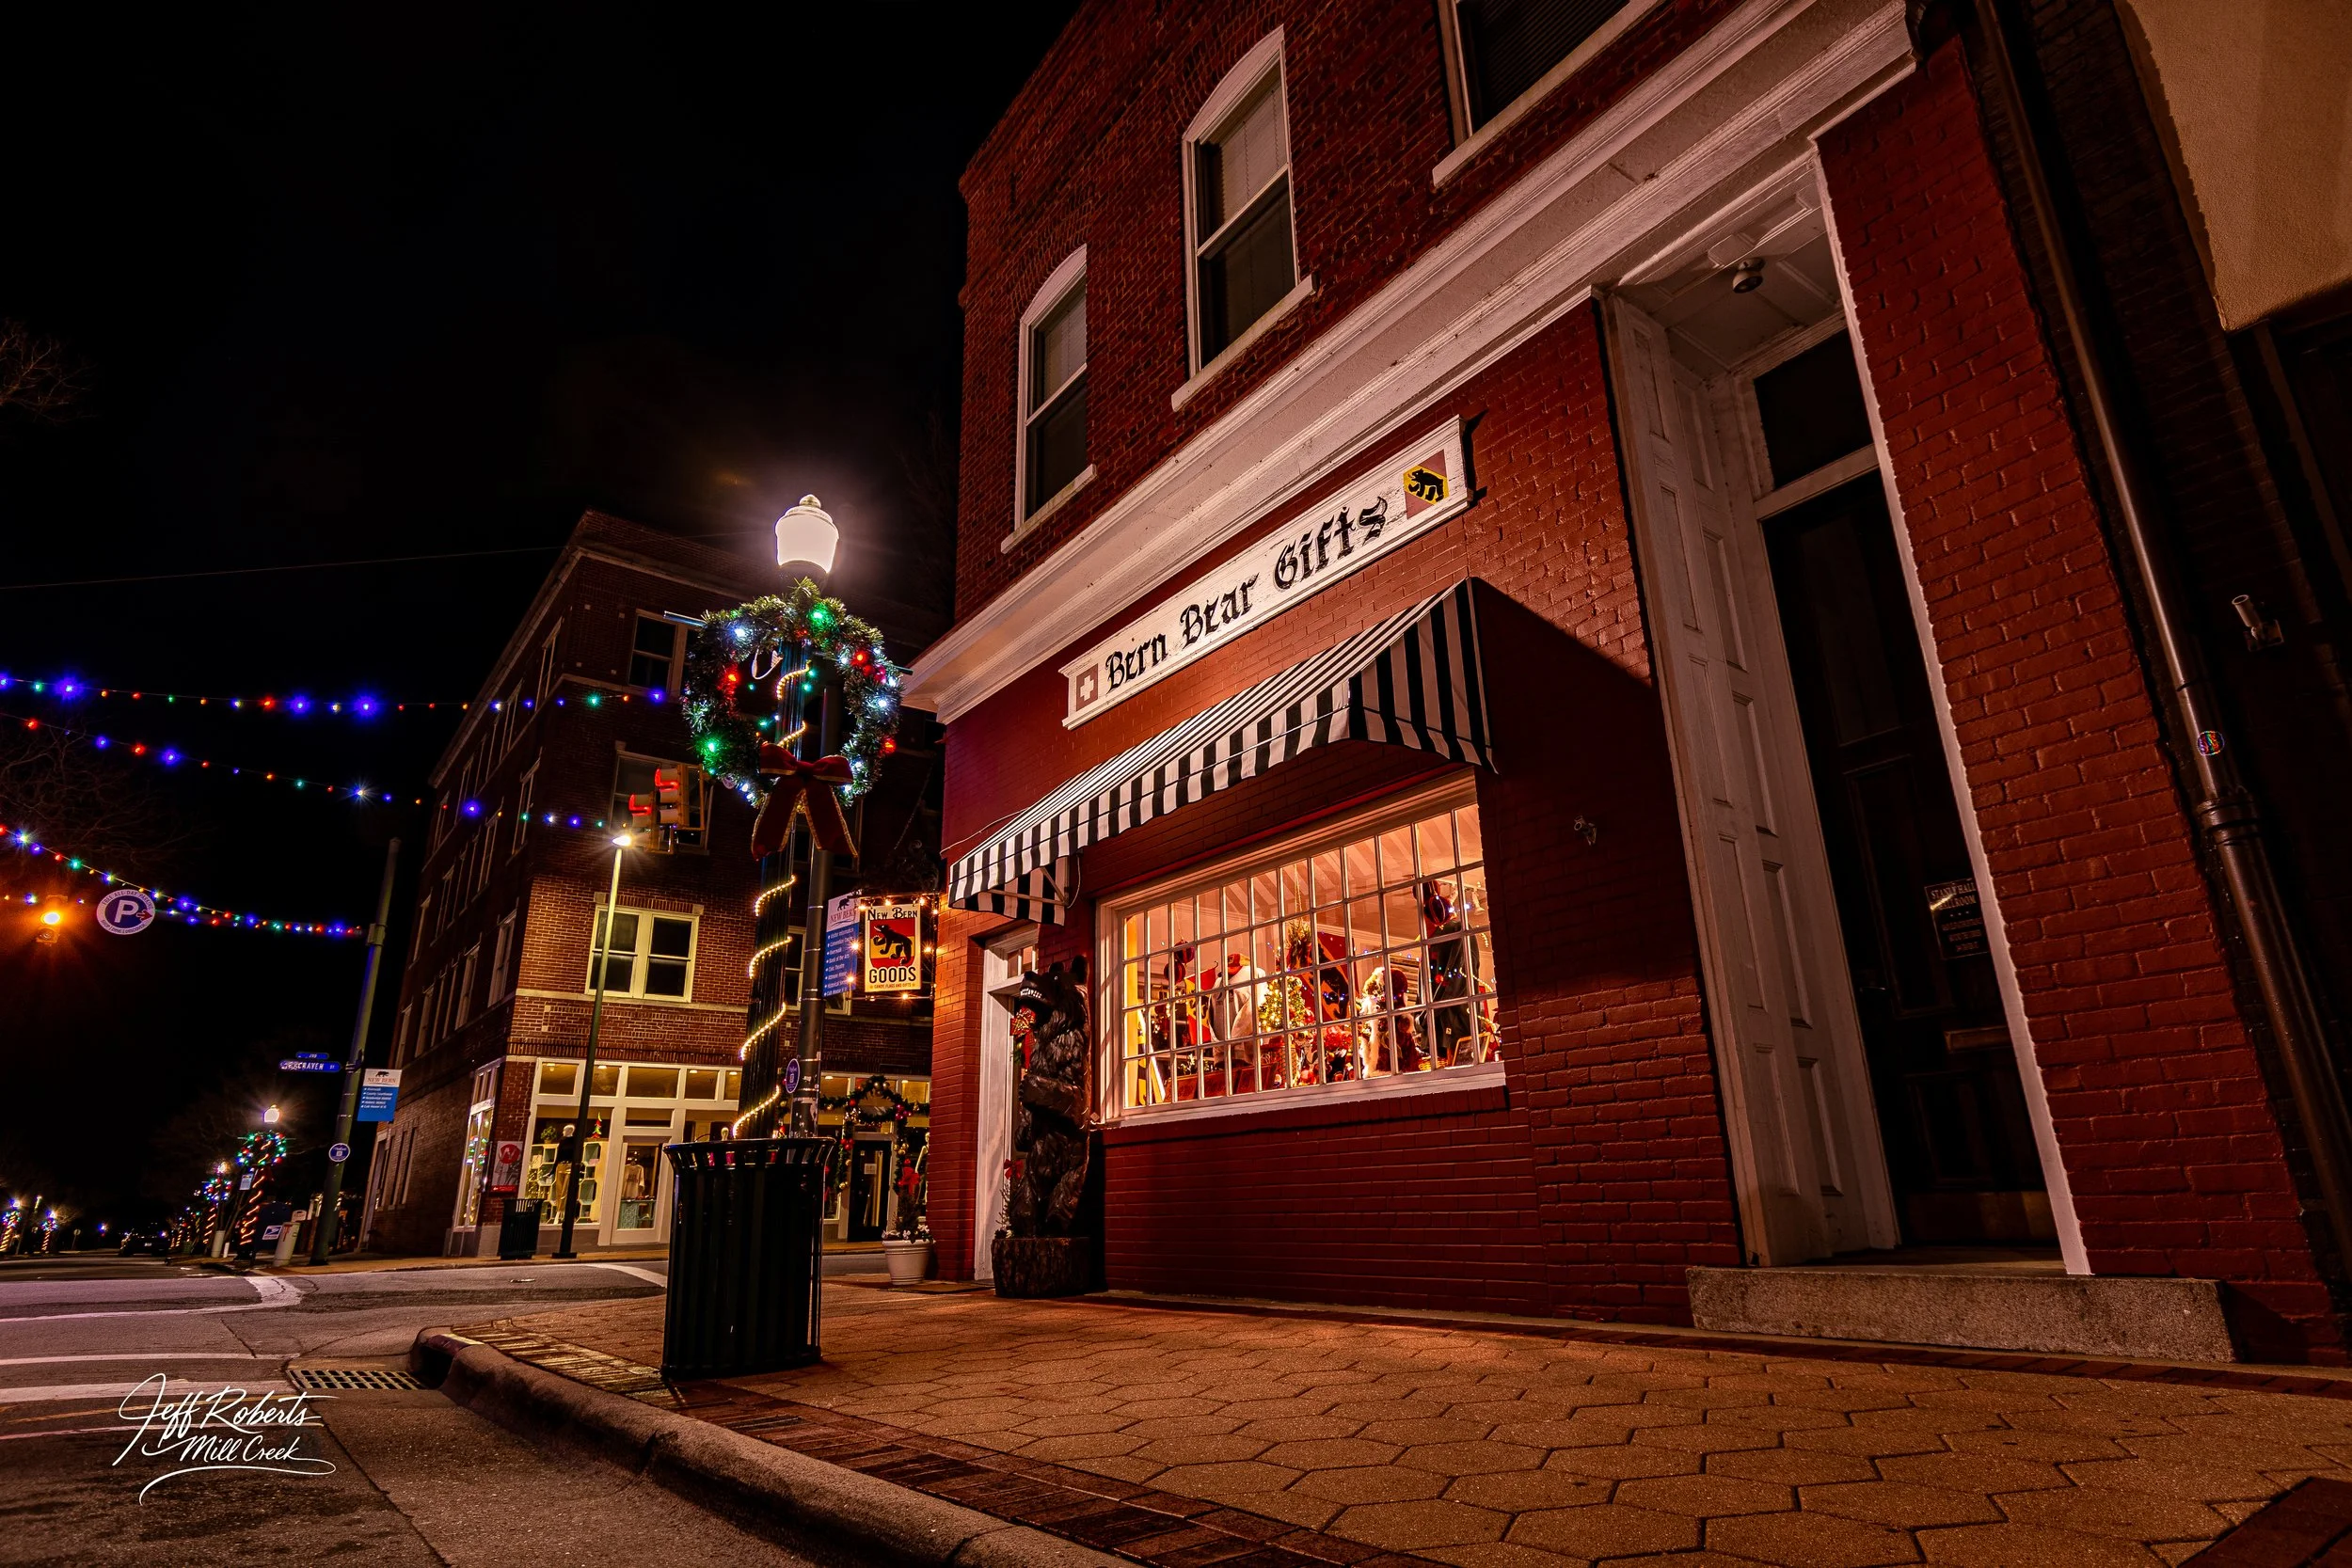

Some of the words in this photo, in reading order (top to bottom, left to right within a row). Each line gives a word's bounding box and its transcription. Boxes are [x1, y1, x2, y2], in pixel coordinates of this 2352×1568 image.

[1104, 633, 1168, 694] Bern
[1179, 572, 1259, 647] Bear
[1274, 496, 1388, 590] Gifts
[114, 899, 139, 923] P
[830, 912, 846, 923] NEW
[868, 966, 916, 983] GOODS
[297, 1061, 325, 1070] CRAVEN
